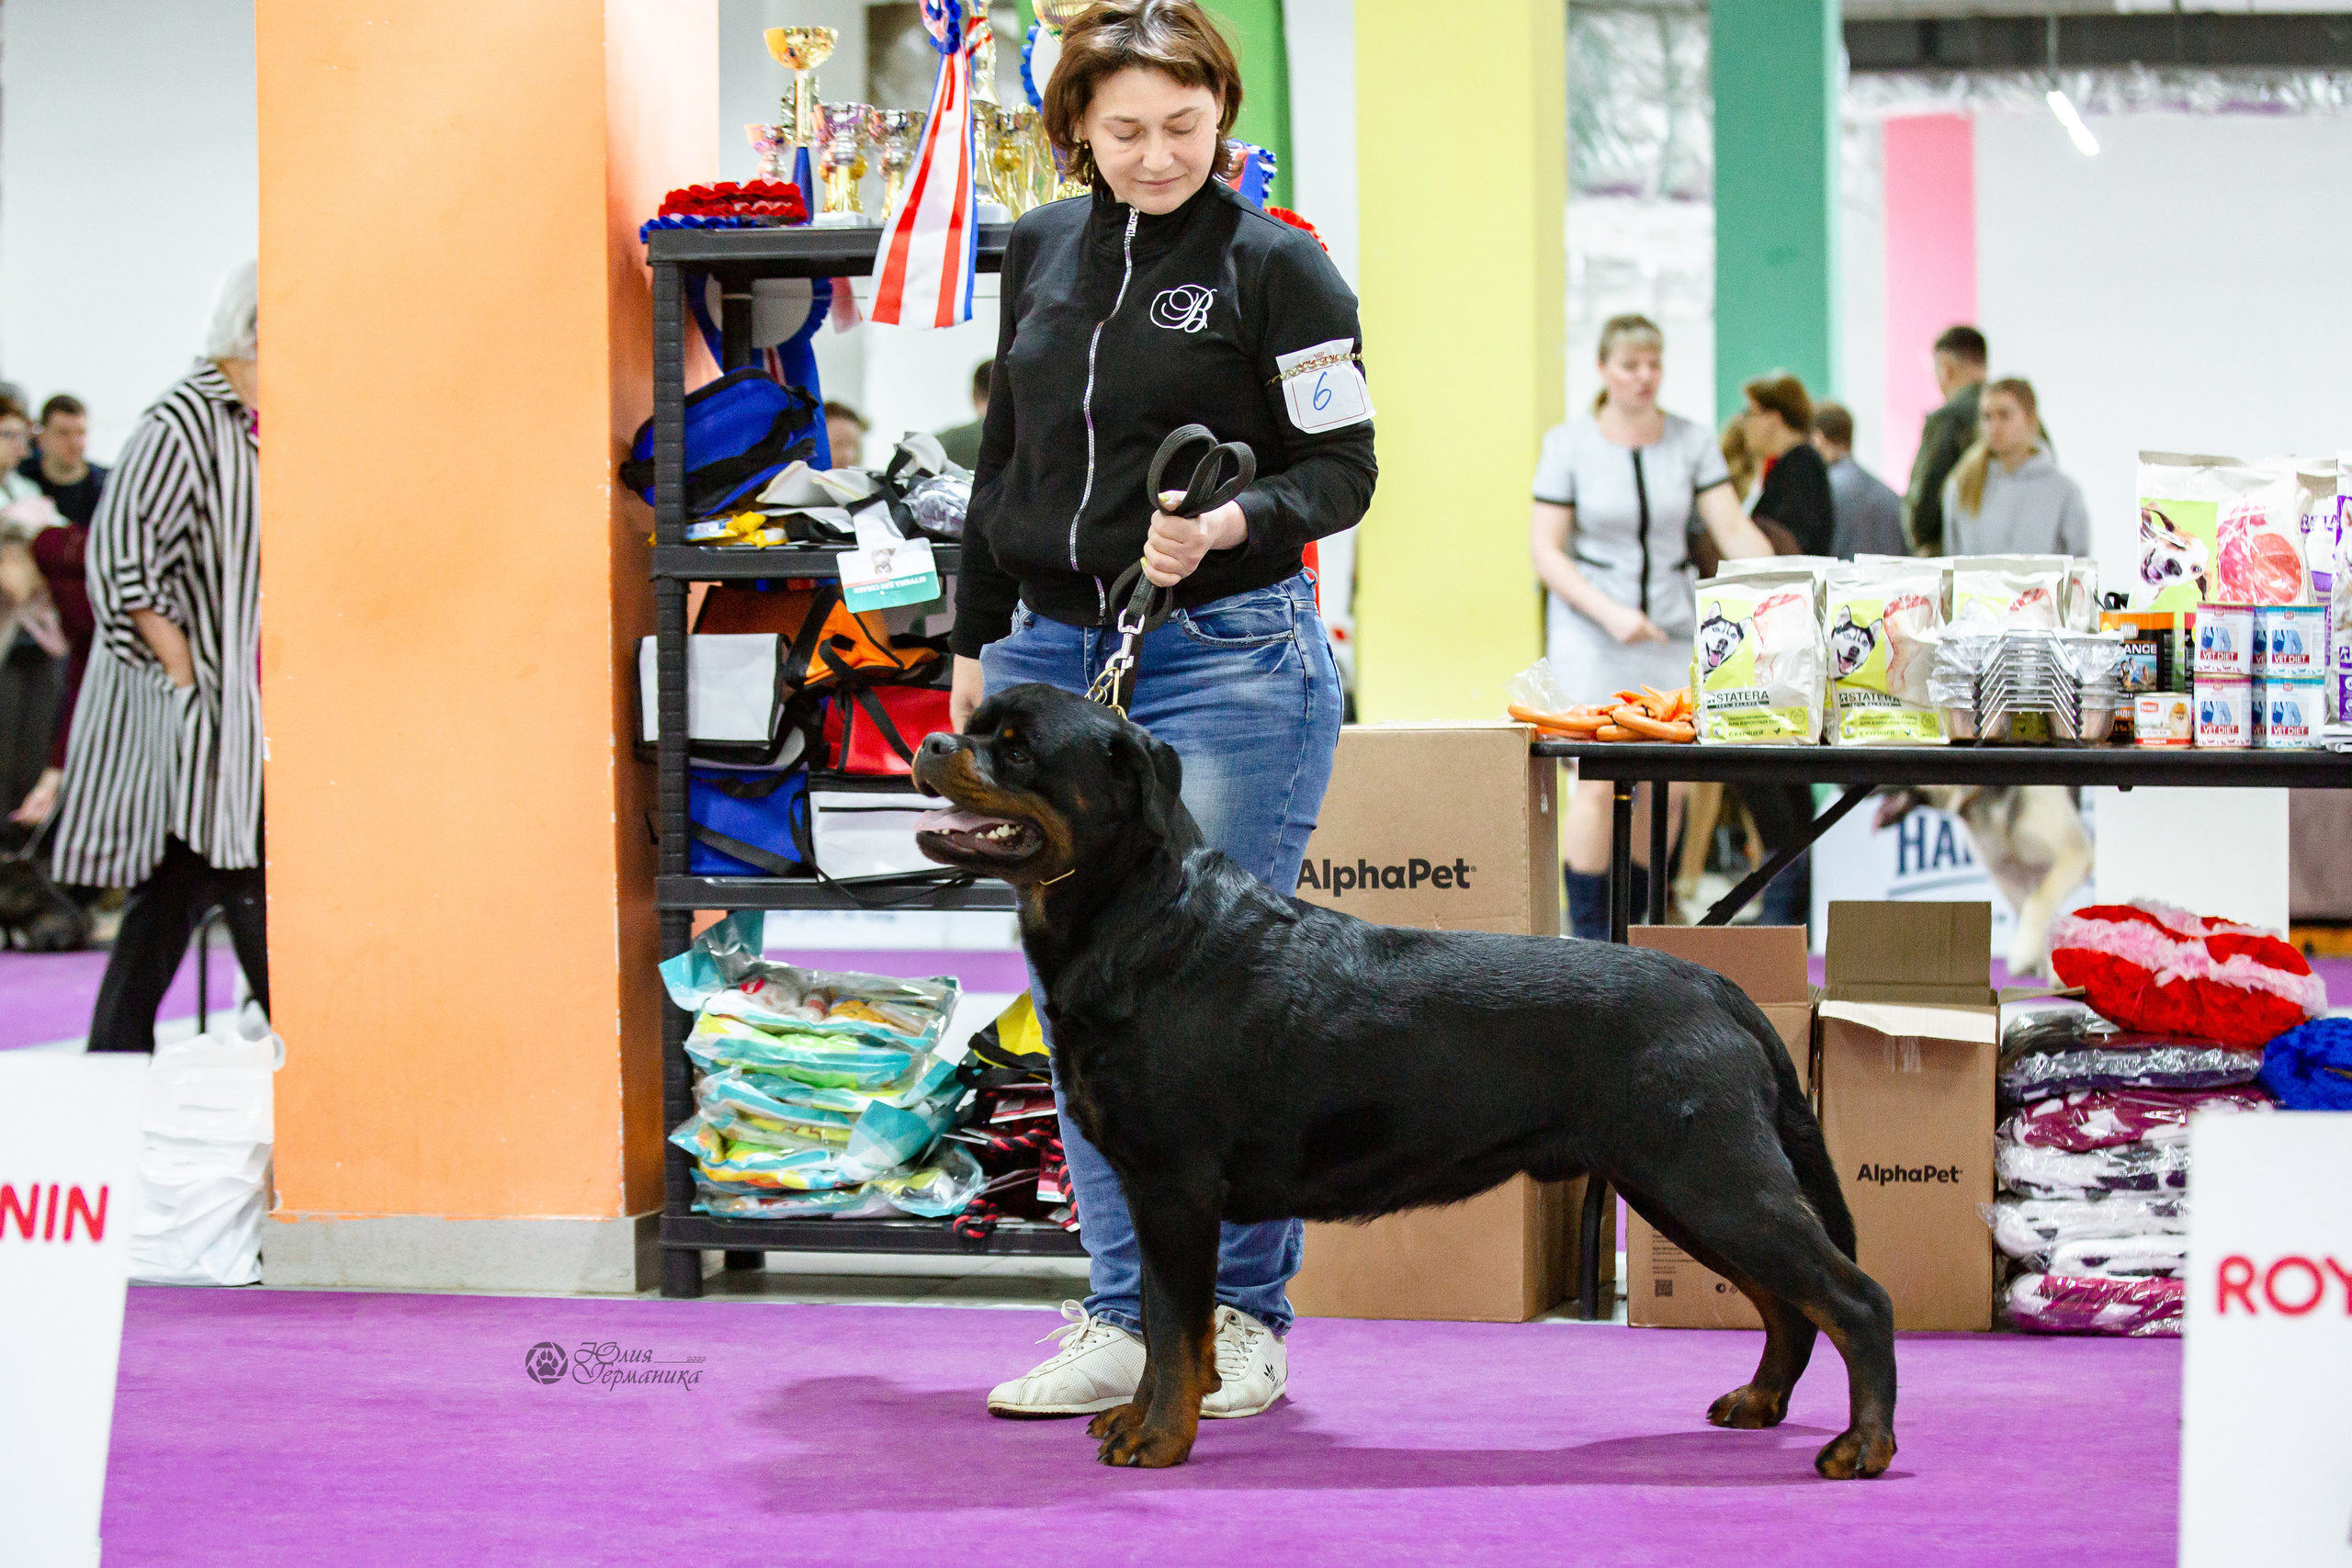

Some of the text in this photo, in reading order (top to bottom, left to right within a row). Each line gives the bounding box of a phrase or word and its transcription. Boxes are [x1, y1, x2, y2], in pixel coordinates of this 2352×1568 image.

[1313, 371, 1332, 411] 6
[2202, 651, 2235, 660] VET DIET
[2274, 655, 2305, 663] VET DIET
[2203, 726, 2235, 735] VET DIET
[2273, 727, 2305, 735] VET DIET
[1898, 814, 1973, 876] HA
[1857, 1163, 1960, 1186] AlphaPet
[0, 1183, 108, 1243] NIN
